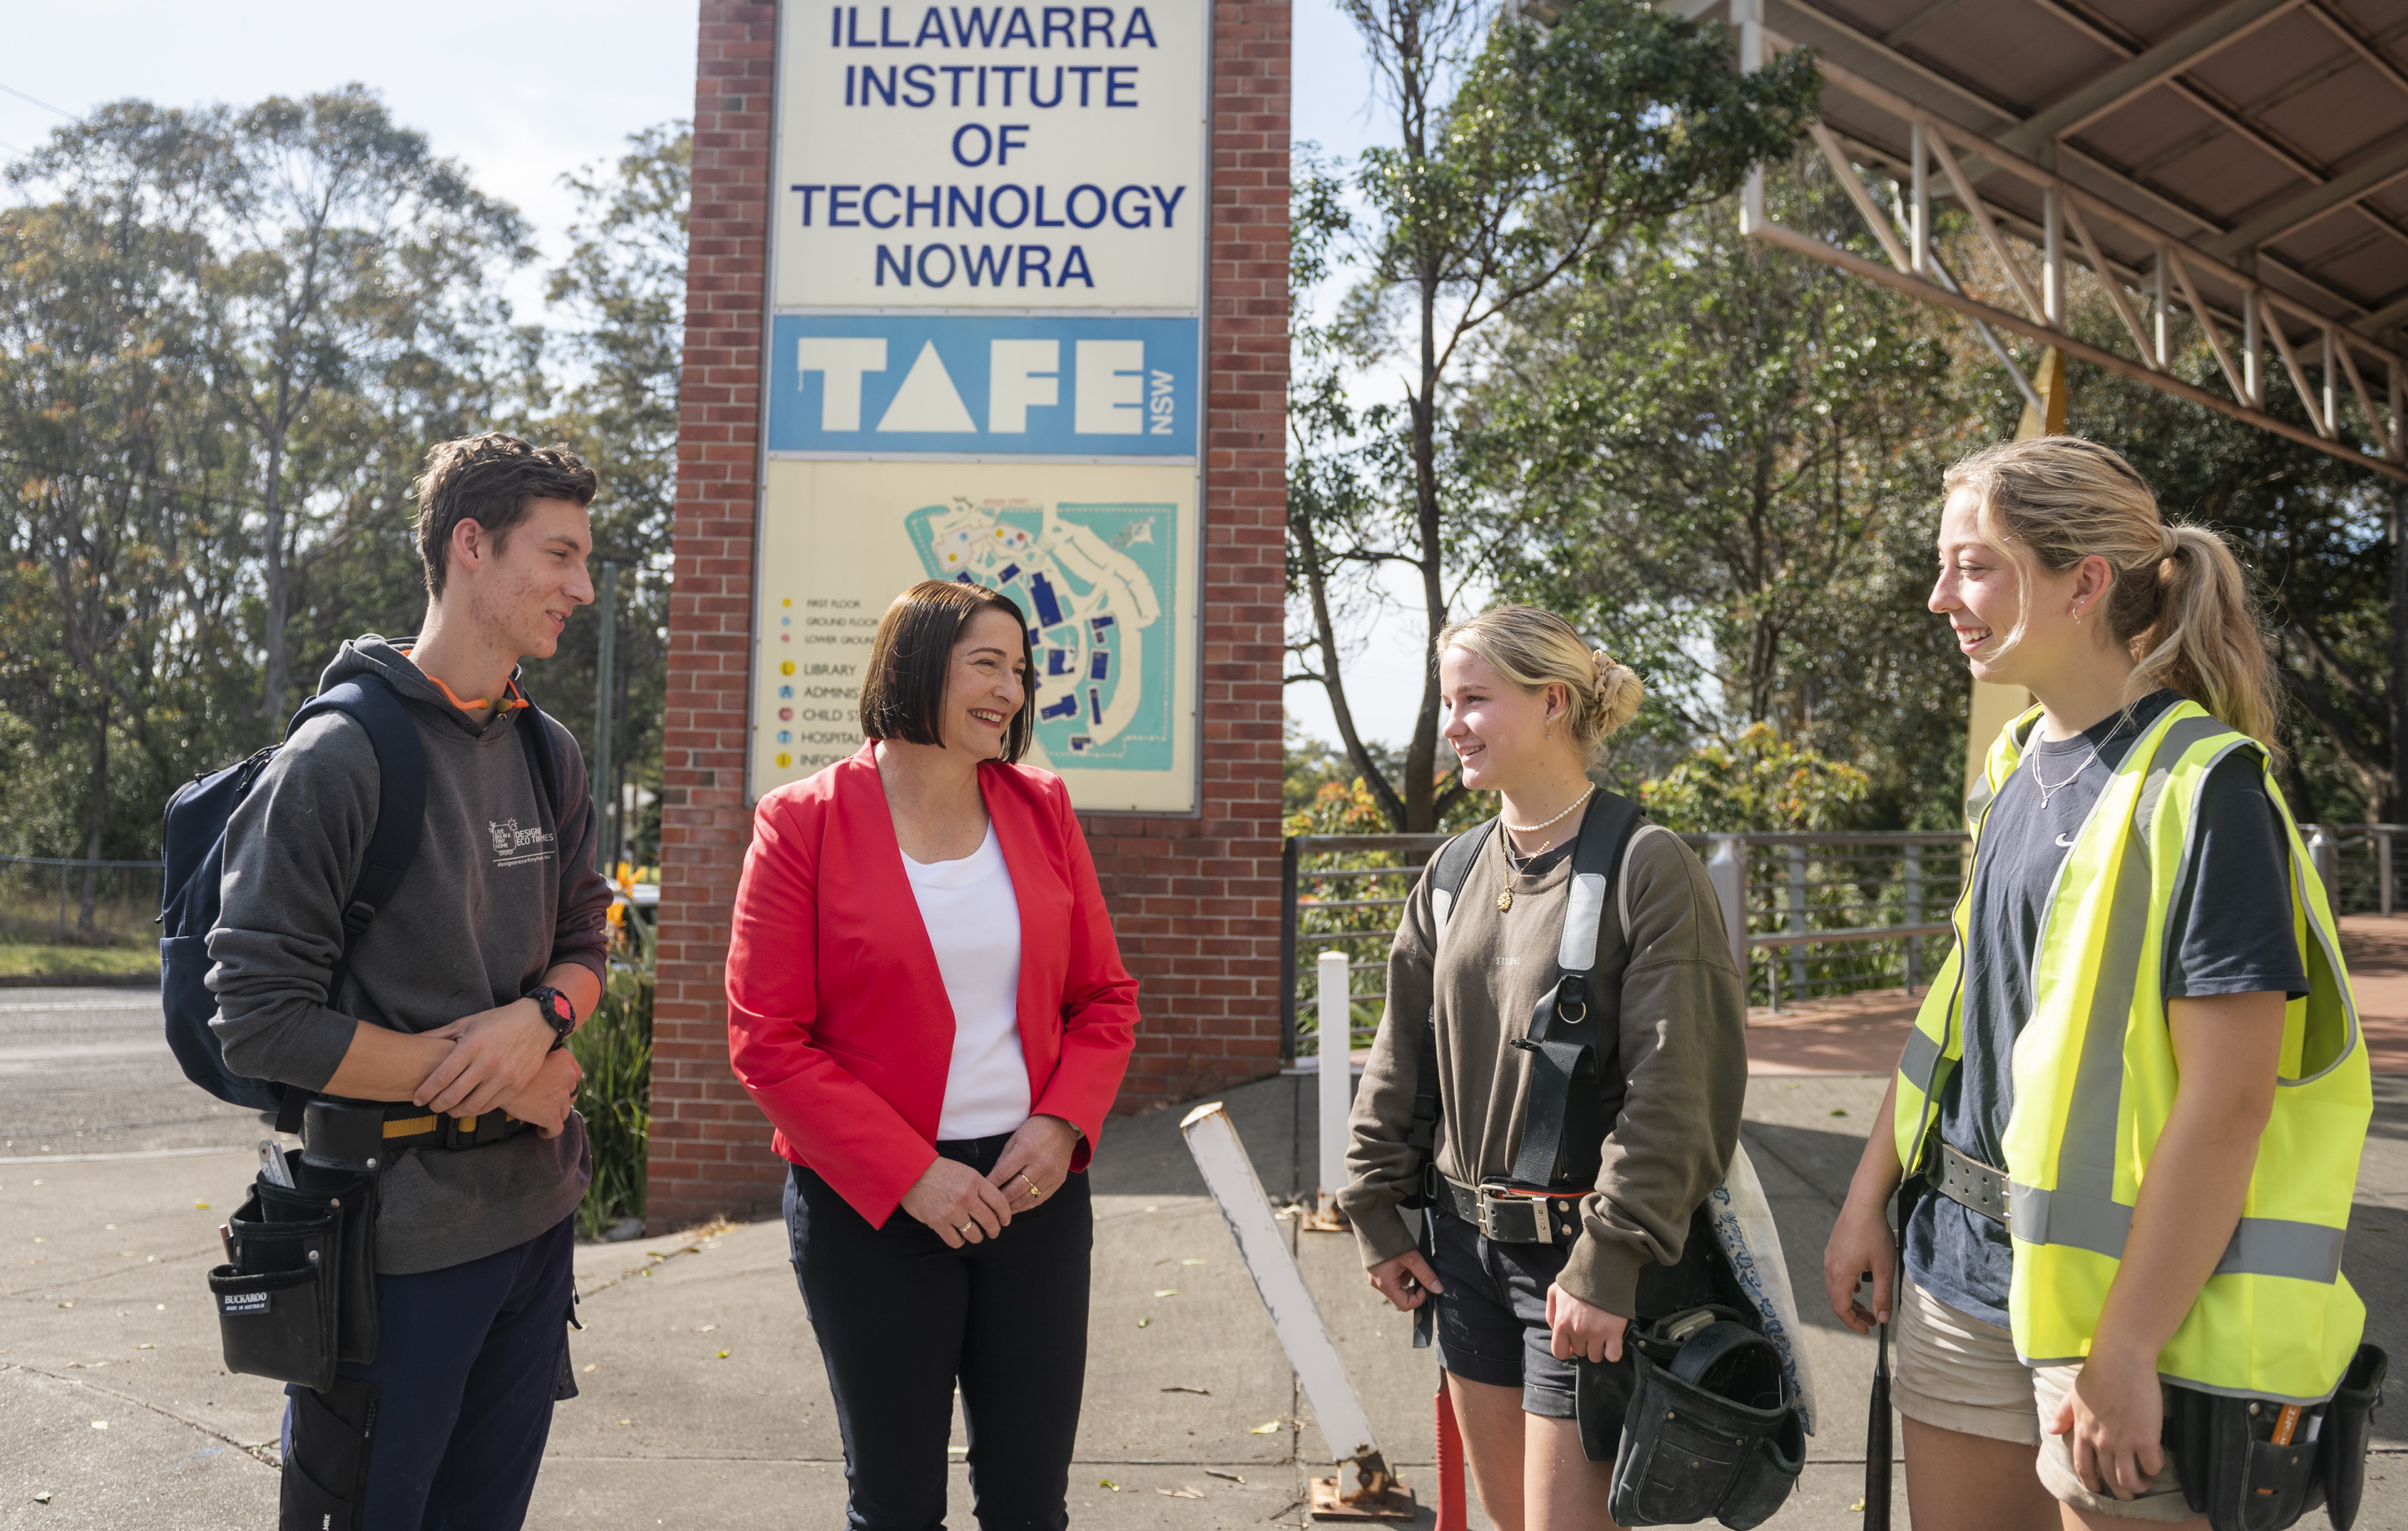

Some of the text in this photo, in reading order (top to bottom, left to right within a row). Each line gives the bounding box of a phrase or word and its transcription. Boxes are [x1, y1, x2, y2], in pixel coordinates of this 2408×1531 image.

[831, 7, 1158, 49] ILLAWARRA
[845, 64, 1139, 108] INSTITUTE
[952, 123, 1030, 167] OF
[790, 183, 1186, 229] TECHNOLOGY
[875, 243, 1095, 288] NOWRA
[797, 337, 1144, 435] TAFE
[1150, 369, 1176, 436] NSW
[807, 599, 861, 609] FIRST FLOOR
[806, 616, 878, 627] GROUND FLOOR
[805, 634, 876, 645] LOWER GROUN
[804, 663, 857, 676] LIBRARY
[802, 708, 843, 721] CHILD
[801, 730, 864, 744] HOSPITALI
[800, 753, 842, 767] INFOR
[515, 827, 541, 838] DESIGNE
[516, 837, 531, 846] ECO
[1496, 957, 1520, 965] THRILLS
[225, 1292, 267, 1304] BUCKAROO
[323, 1514, 331, 1531] MRK
